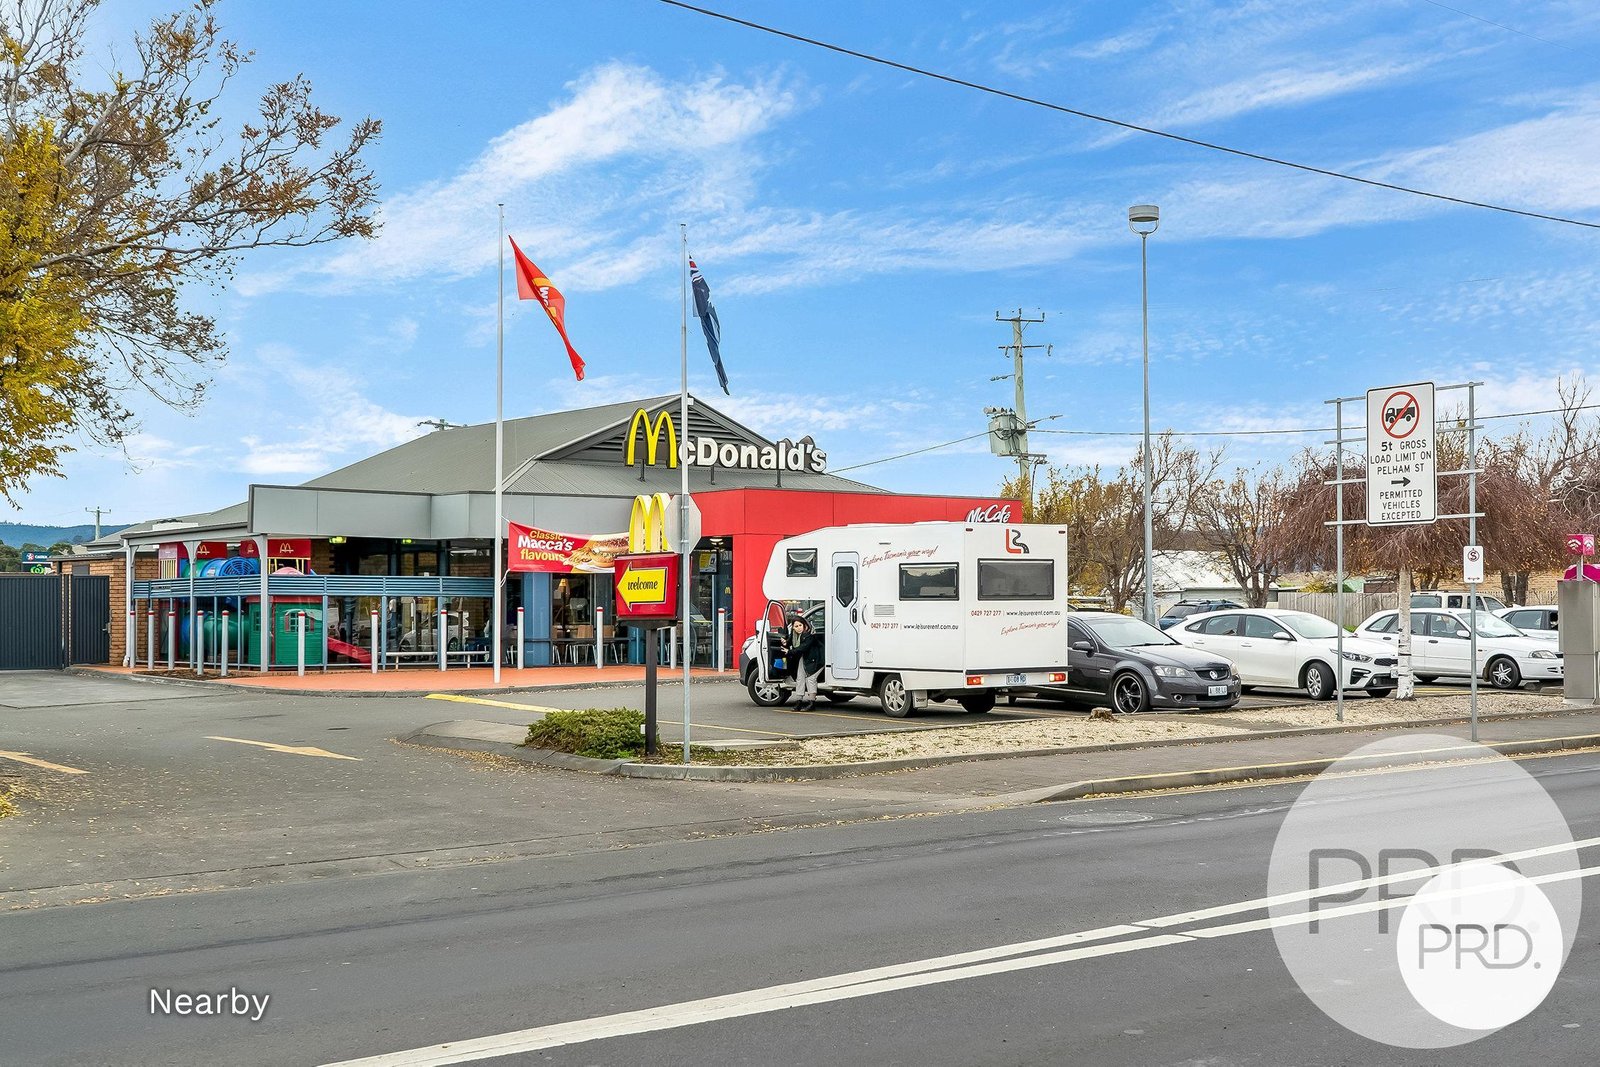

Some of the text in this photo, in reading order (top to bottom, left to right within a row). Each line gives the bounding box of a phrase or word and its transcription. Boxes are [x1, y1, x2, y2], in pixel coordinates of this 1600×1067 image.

[624, 407, 827, 473] McDonald's
[1381, 439, 1427, 452] 5t GROSS
[1370, 451, 1432, 464] LOAD LIMIT ON
[1377, 463, 1425, 475] PELHAM ST
[1379, 489, 1423, 499] PERMITTED
[1382, 500, 1421, 510] VEHICLES
[1381, 510, 1421, 520] EXCEPTED
[529, 530, 563, 541] Classic
[517, 535, 574, 551] Macca's
[520, 549, 565, 561] flavours
[627, 576, 659, 591] welcome
